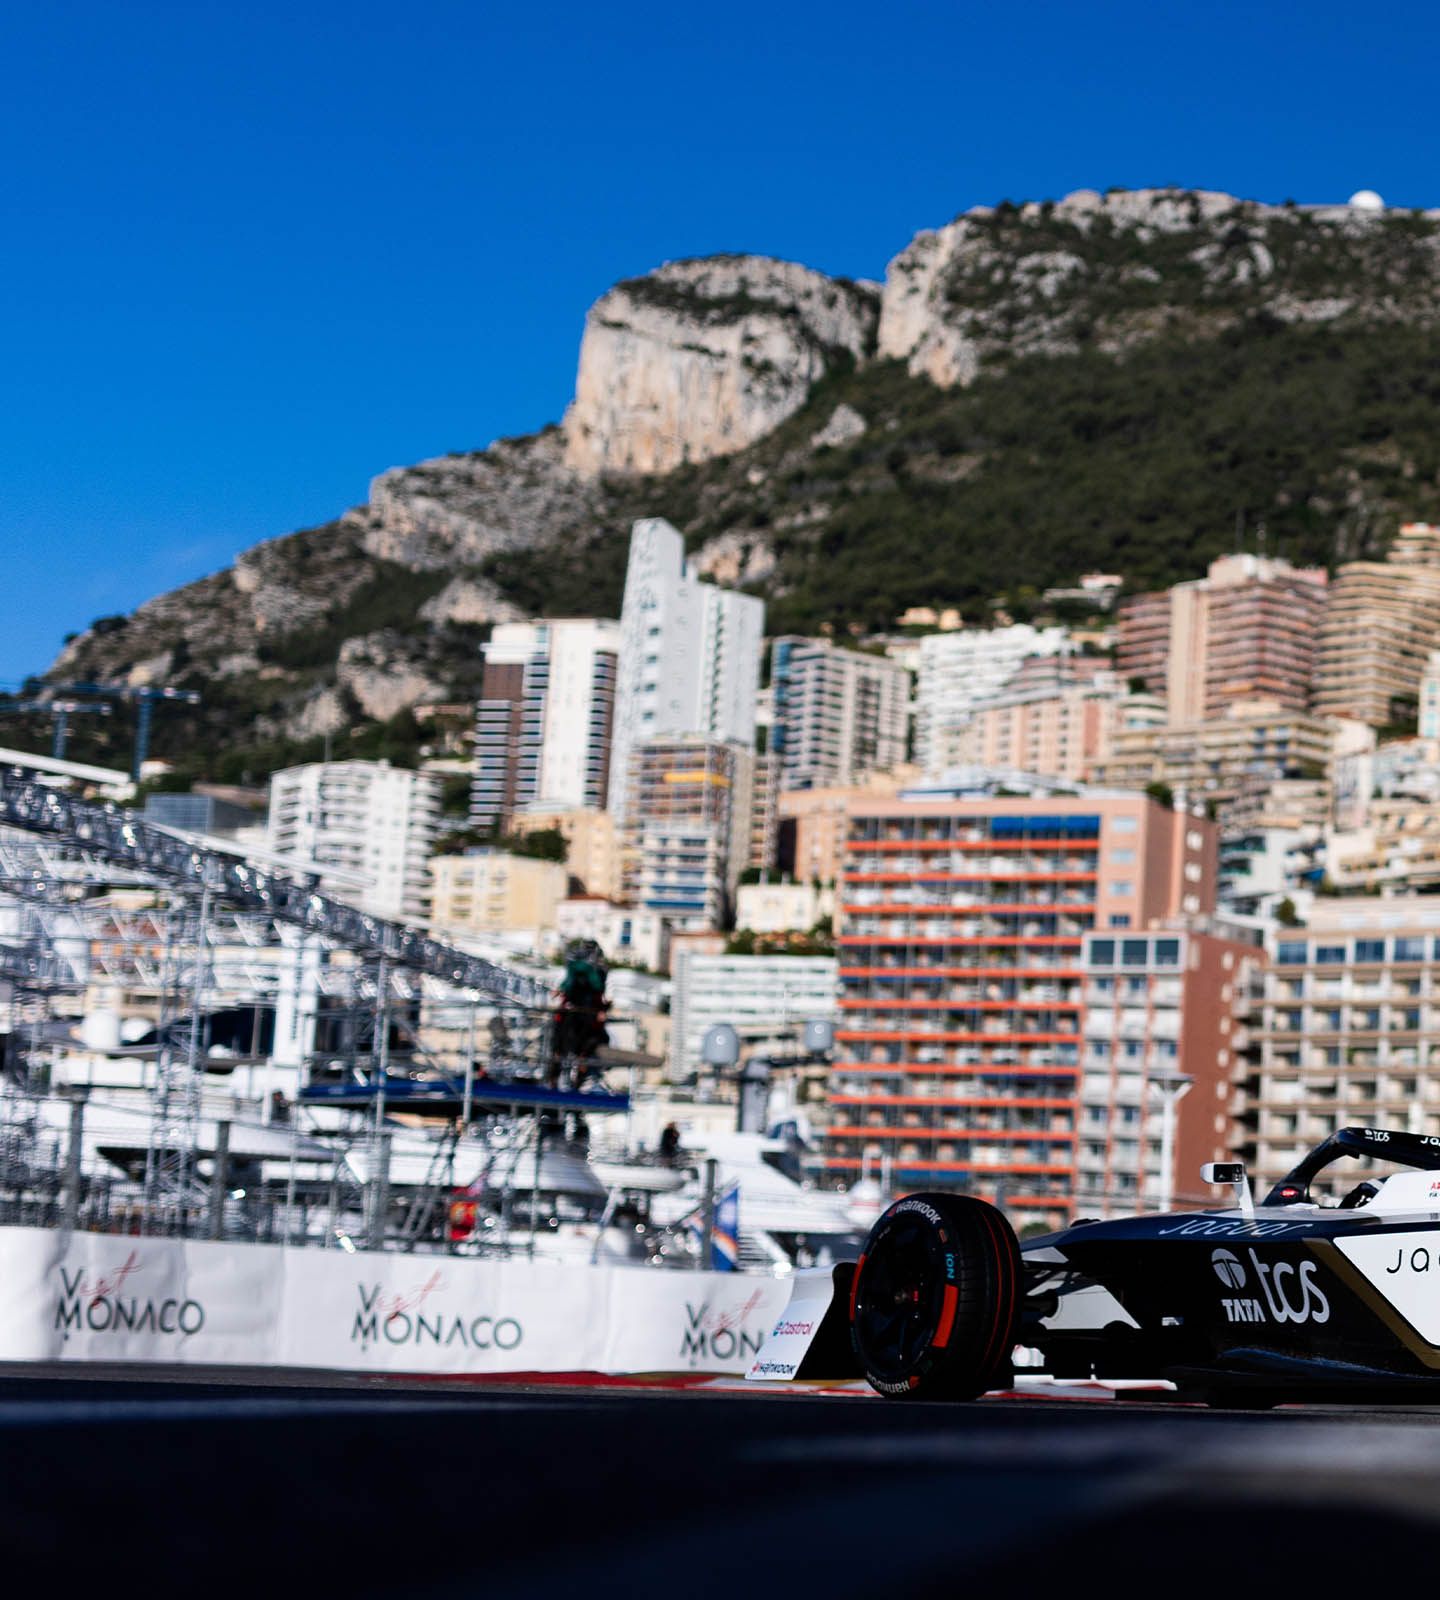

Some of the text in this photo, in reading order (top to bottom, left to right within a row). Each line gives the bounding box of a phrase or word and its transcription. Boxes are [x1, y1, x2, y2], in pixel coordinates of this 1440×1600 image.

[1248, 1247, 1330, 1324] tcs
[54, 1296, 206, 1335] MONACO
[1221, 1299, 1267, 1322] TATA
[350, 1311, 522, 1351] MONACO
[679, 1327, 764, 1360] MON
